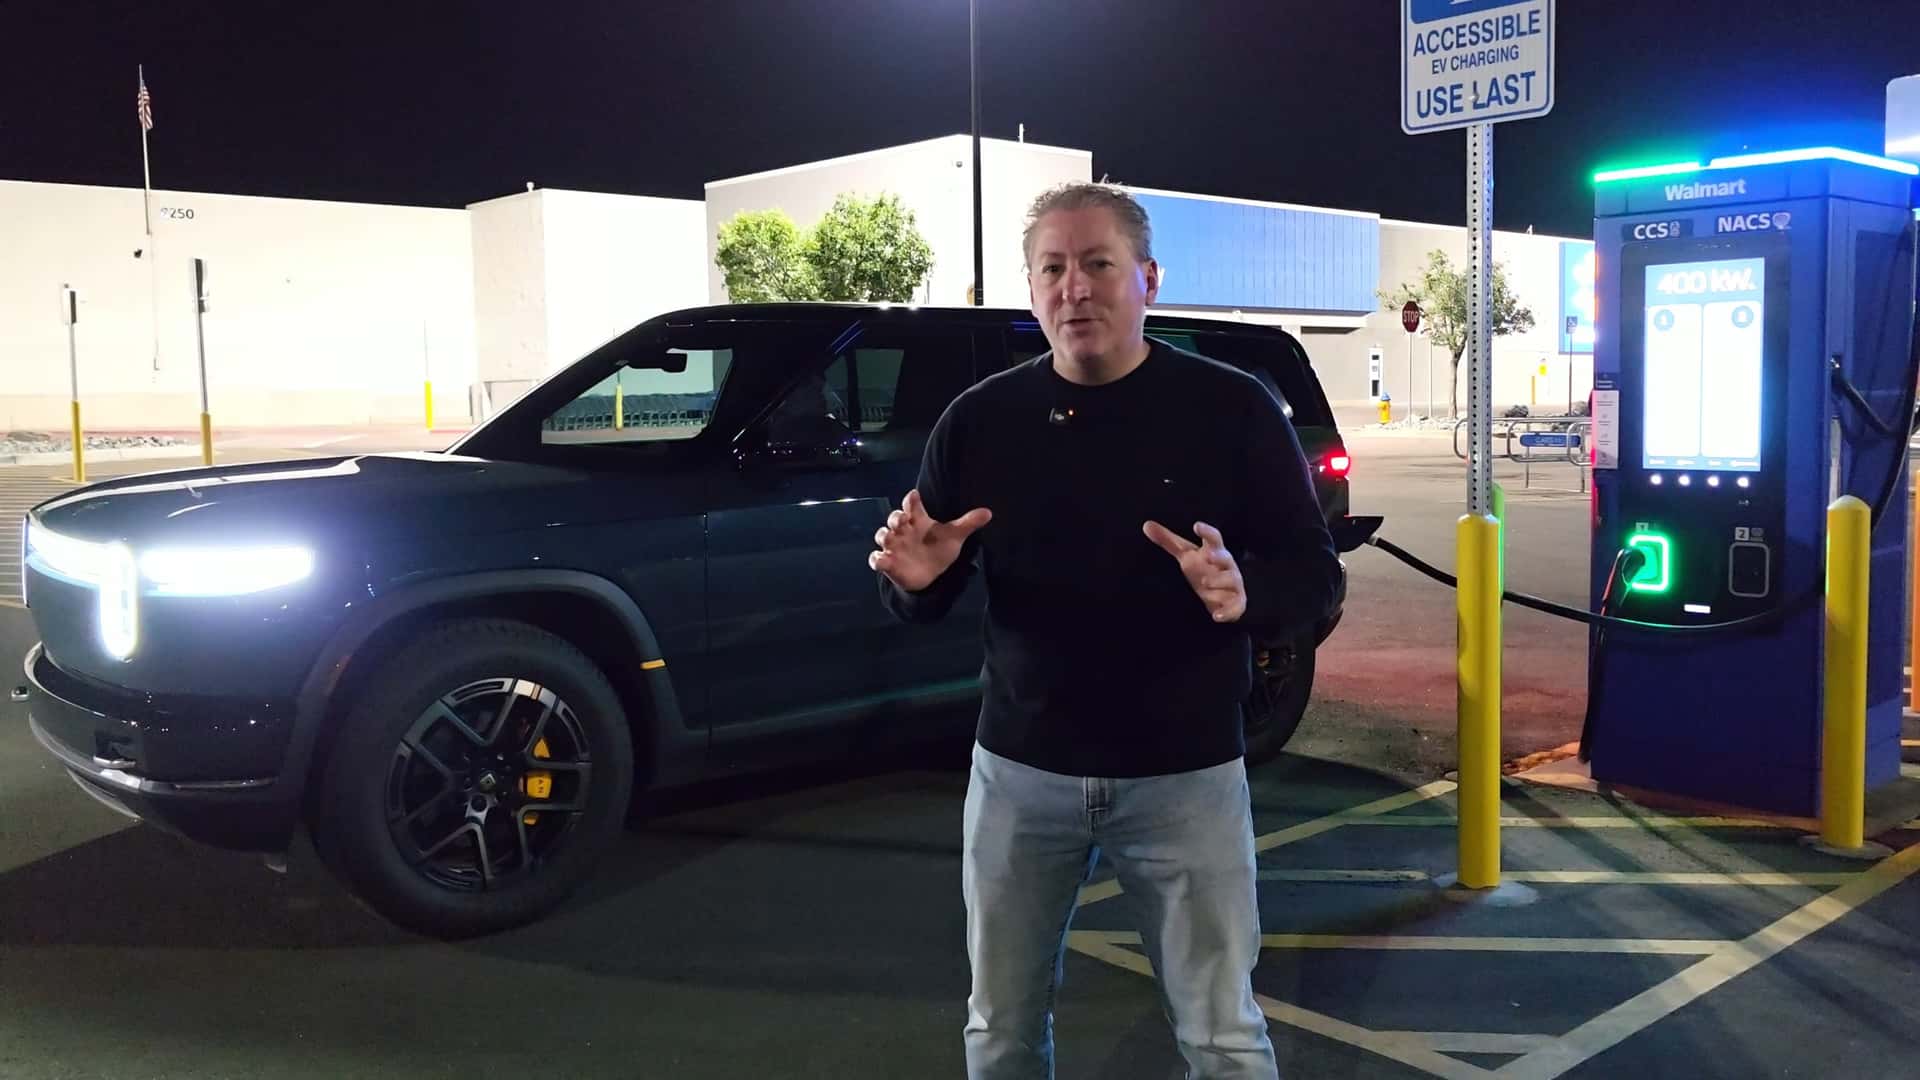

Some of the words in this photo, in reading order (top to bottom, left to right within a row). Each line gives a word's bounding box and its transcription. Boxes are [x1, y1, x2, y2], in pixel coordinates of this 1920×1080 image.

[1413, 9, 1541, 57] ACCESSIBLE
[1431, 58, 1448, 75] EV
[1450, 44, 1520, 71] CHARGING
[1416, 83, 1464, 118] USE
[1472, 70, 1536, 110] LAST
[1664, 178, 1746, 201] Walmart
[1633, 222, 1669, 240] CCS
[1717, 212, 1771, 232] NACS
[1656, 271, 1707, 295] 400
[1403, 310, 1419, 323] STOP
